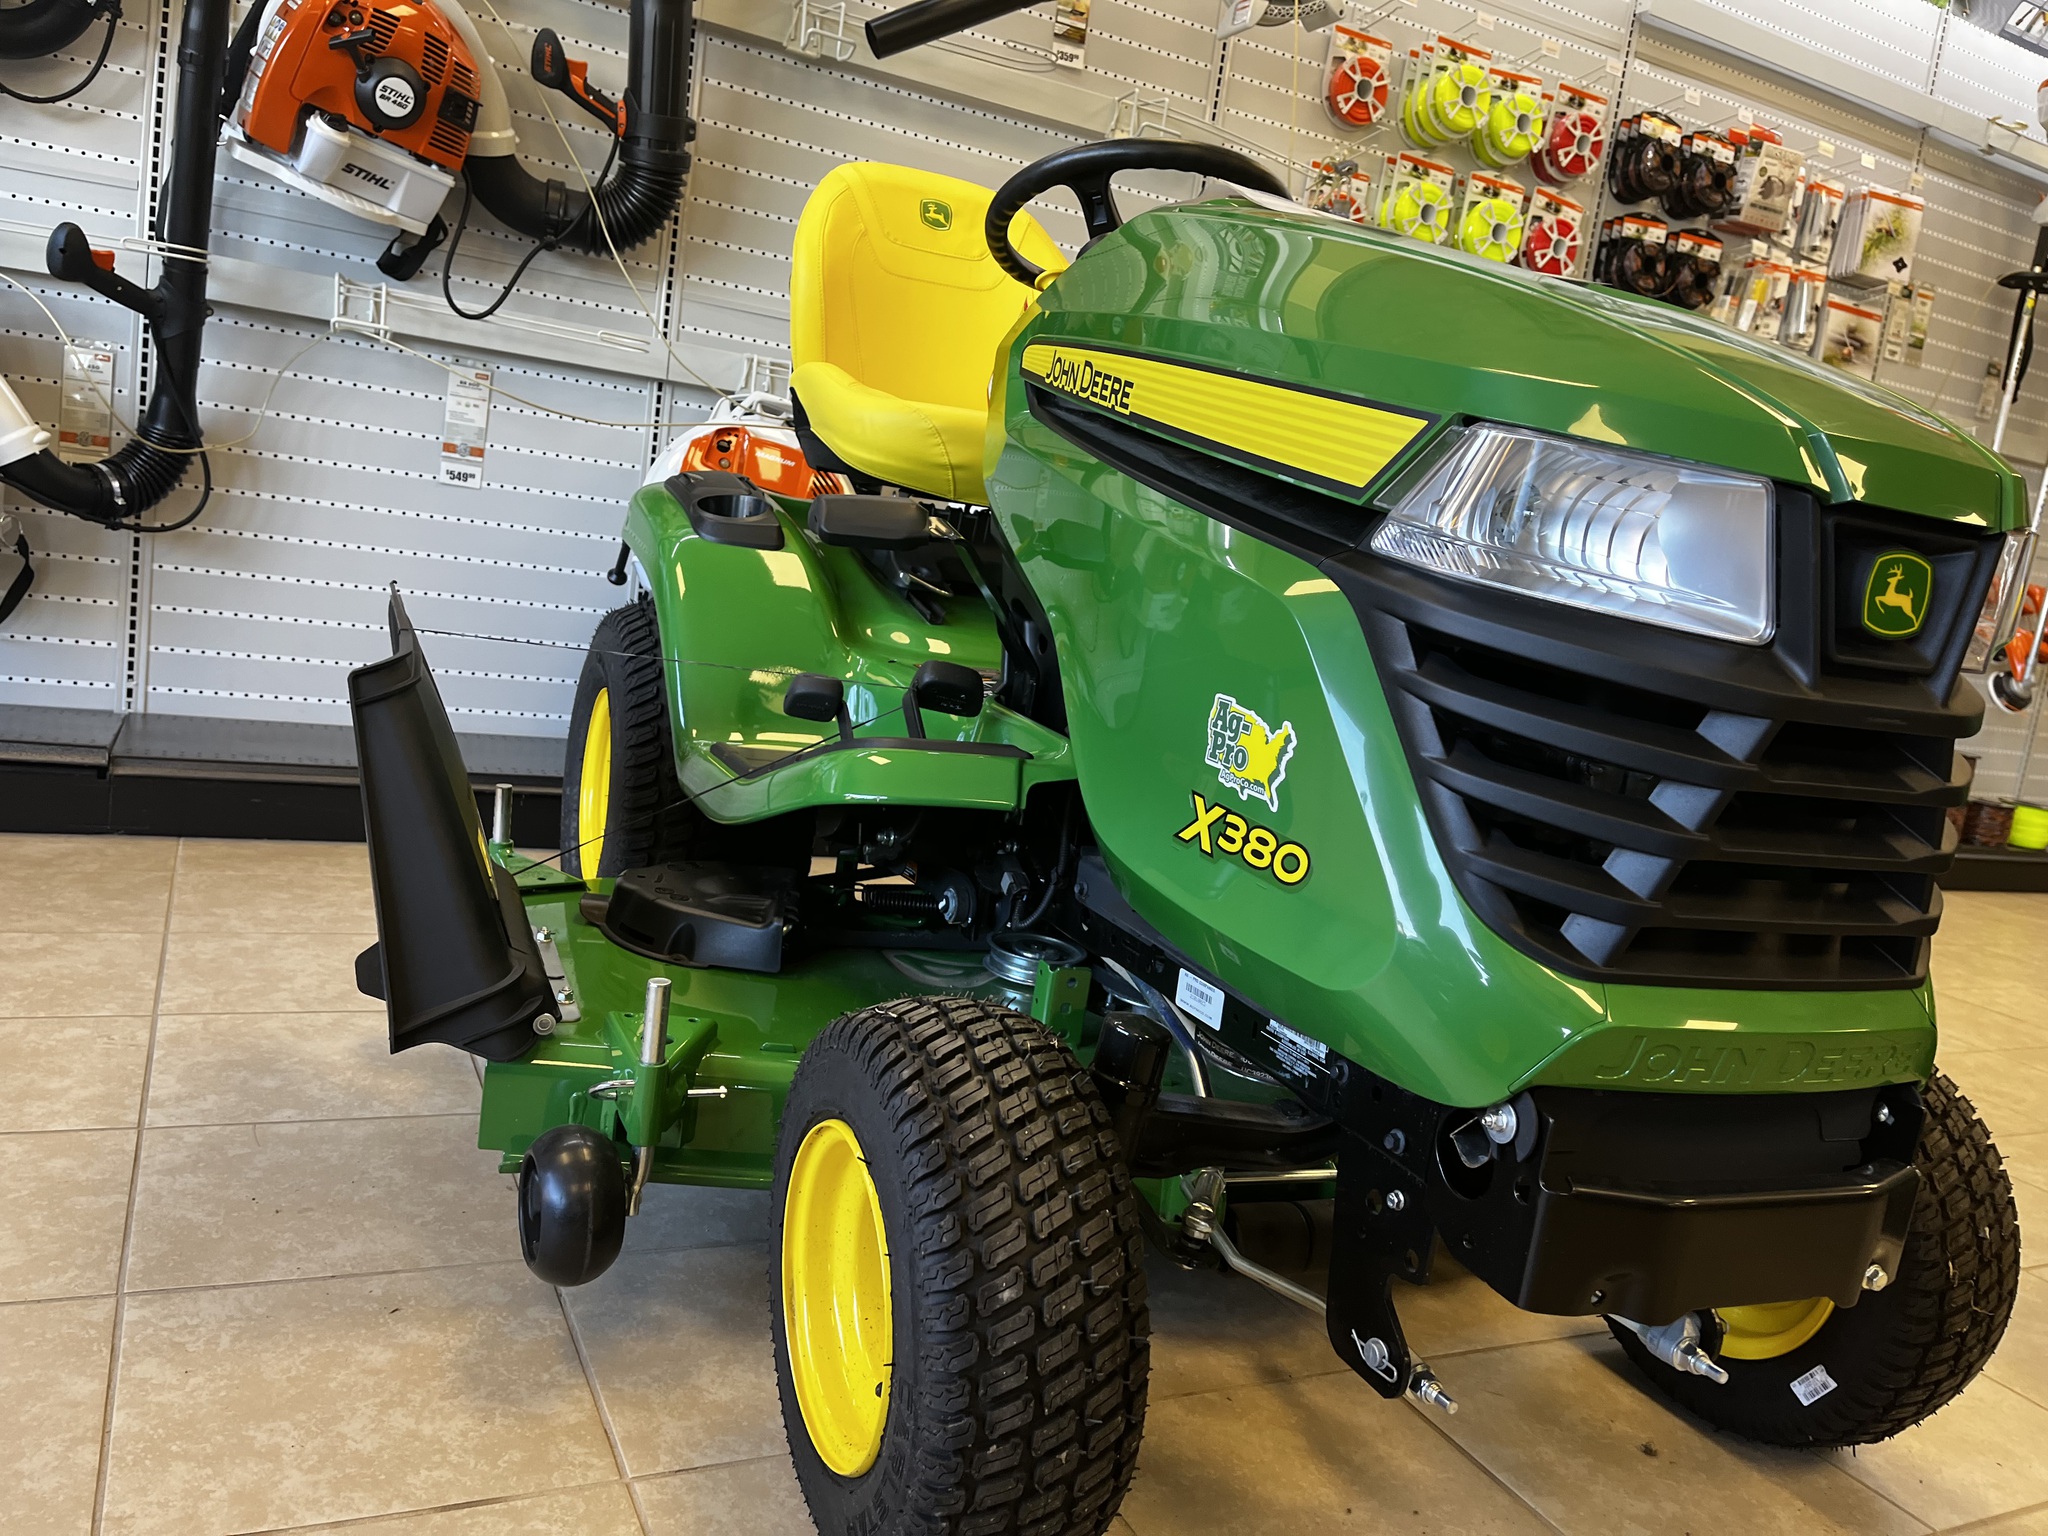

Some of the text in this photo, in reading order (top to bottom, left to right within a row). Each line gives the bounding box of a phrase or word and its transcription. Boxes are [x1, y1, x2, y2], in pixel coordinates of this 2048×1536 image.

[379, 84, 412, 104] STIHL
[341, 162, 391, 190] STIHL
[1045, 349, 1134, 412] JOHN DEERE
[1211, 698, 1252, 743] Ag-
[1207, 730, 1249, 771] Pro
[1219, 769, 1266, 797] AgProCo.com
[1173, 789, 1311, 886] X380
[1594, 1034, 1766, 1084] JOHN
